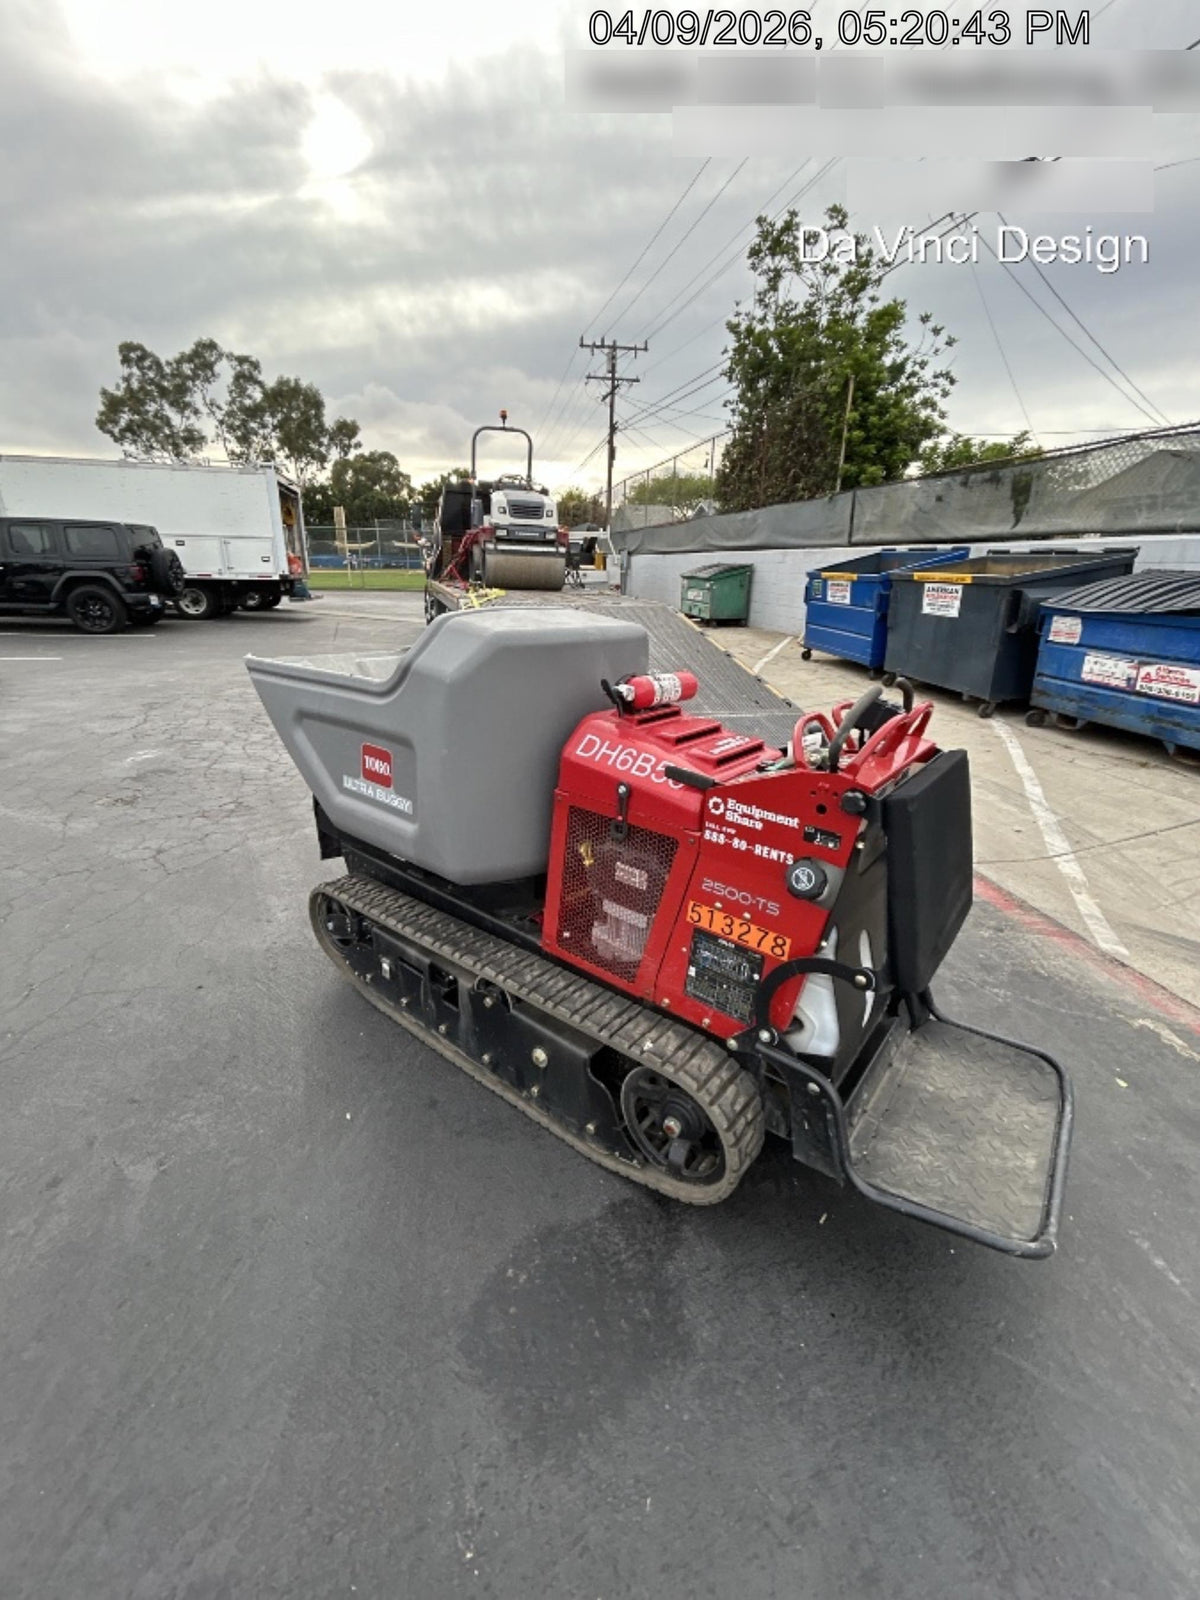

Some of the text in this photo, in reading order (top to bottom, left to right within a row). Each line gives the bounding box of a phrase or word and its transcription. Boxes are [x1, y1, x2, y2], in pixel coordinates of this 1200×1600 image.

[364, 755, 391, 776] TORO
[343, 775, 411, 813] ULTRA BUGGY
[725, 810, 763, 831] Share
[727, 798, 800, 829] Equipment
[690, 902, 787, 957] 513278
